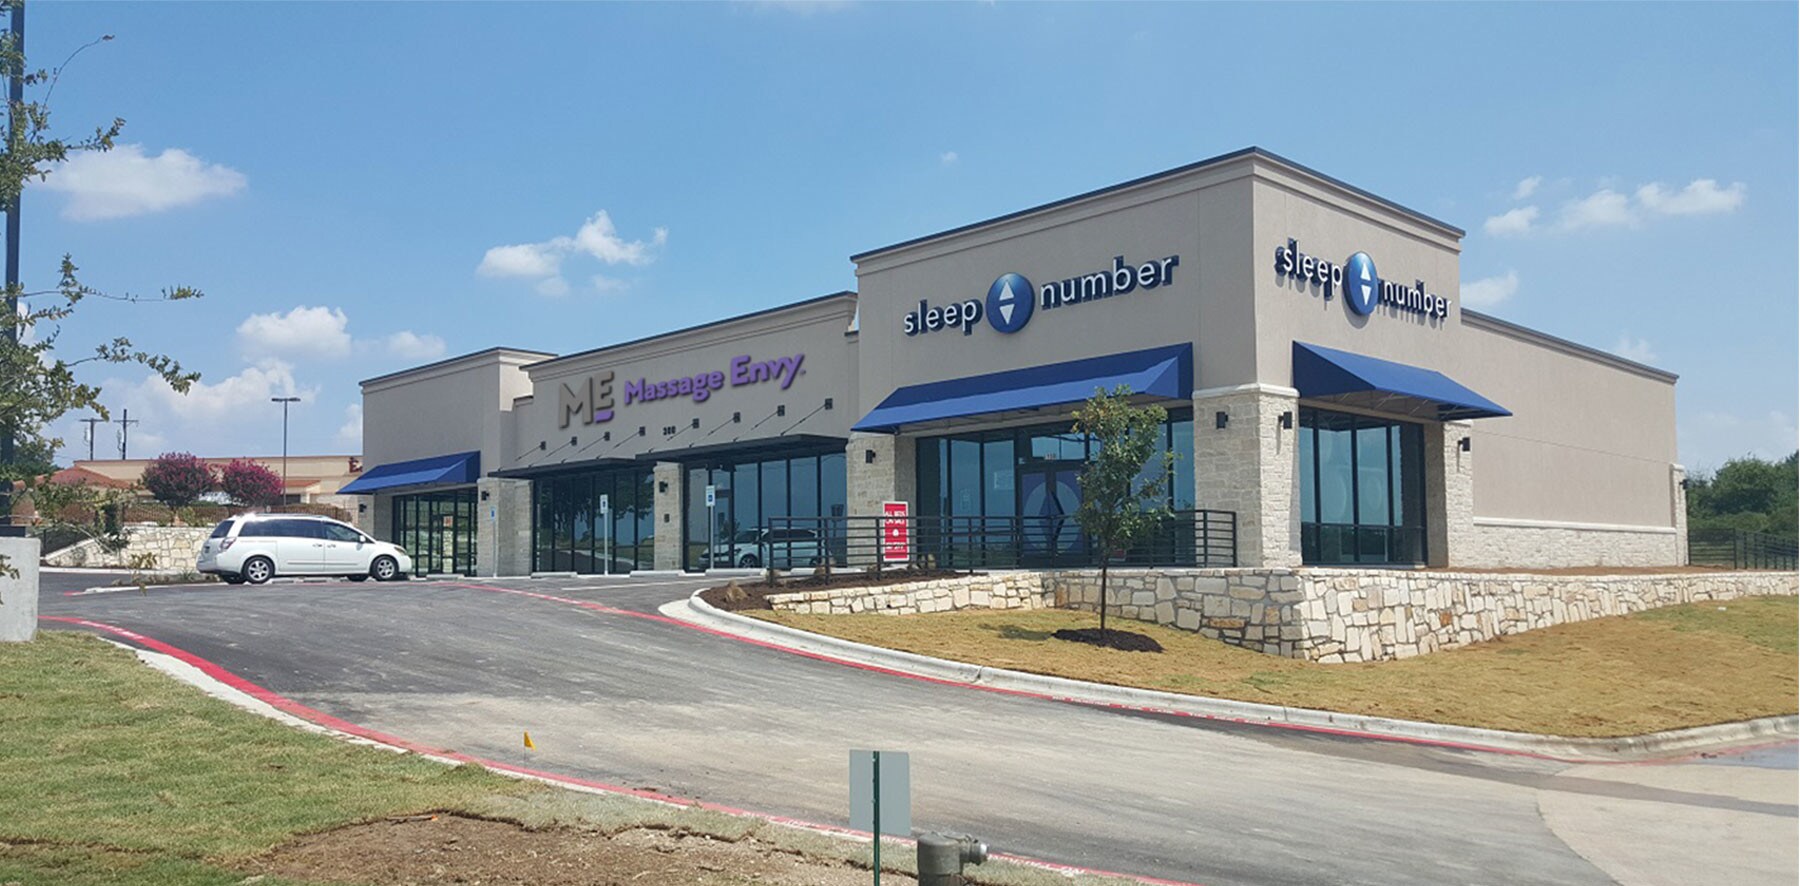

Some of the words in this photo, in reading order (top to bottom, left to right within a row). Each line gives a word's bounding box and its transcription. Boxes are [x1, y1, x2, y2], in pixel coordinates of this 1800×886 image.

[903, 299, 982, 336] sleep
[1040, 255, 1179, 310] number
[1278, 239, 1343, 300] sleep
[1381, 280, 1453, 318] number
[559, 370, 615, 430] ME
[624, 371, 725, 405] Massage
